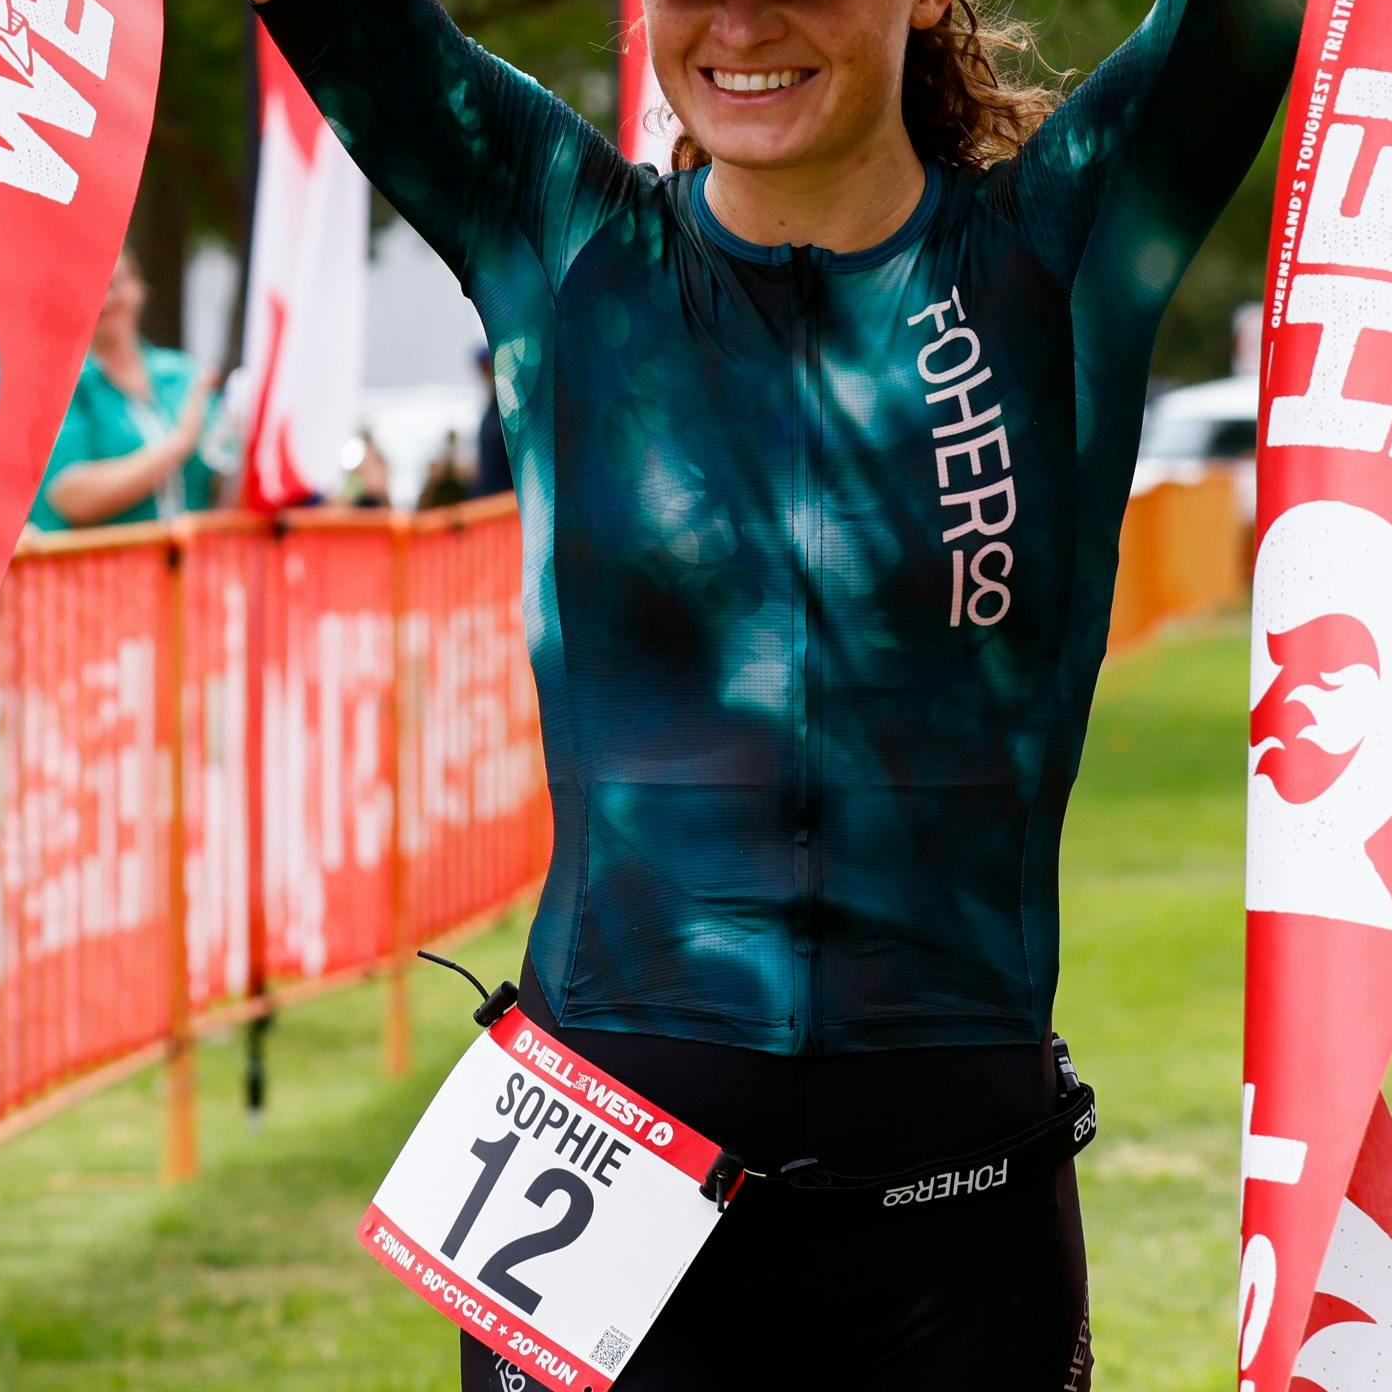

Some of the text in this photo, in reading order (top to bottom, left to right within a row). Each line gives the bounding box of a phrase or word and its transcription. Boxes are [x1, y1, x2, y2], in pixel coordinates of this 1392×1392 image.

[1270, 179, 1306, 329] QUEENSLAND'S
[1296, 68, 1333, 170] TOUGHEST
[527, 1040, 575, 1088] HELL
[586, 1079, 654, 1133] WEST
[495, 1072, 632, 1187] SOPHIE
[439, 1131, 595, 1316] 12
